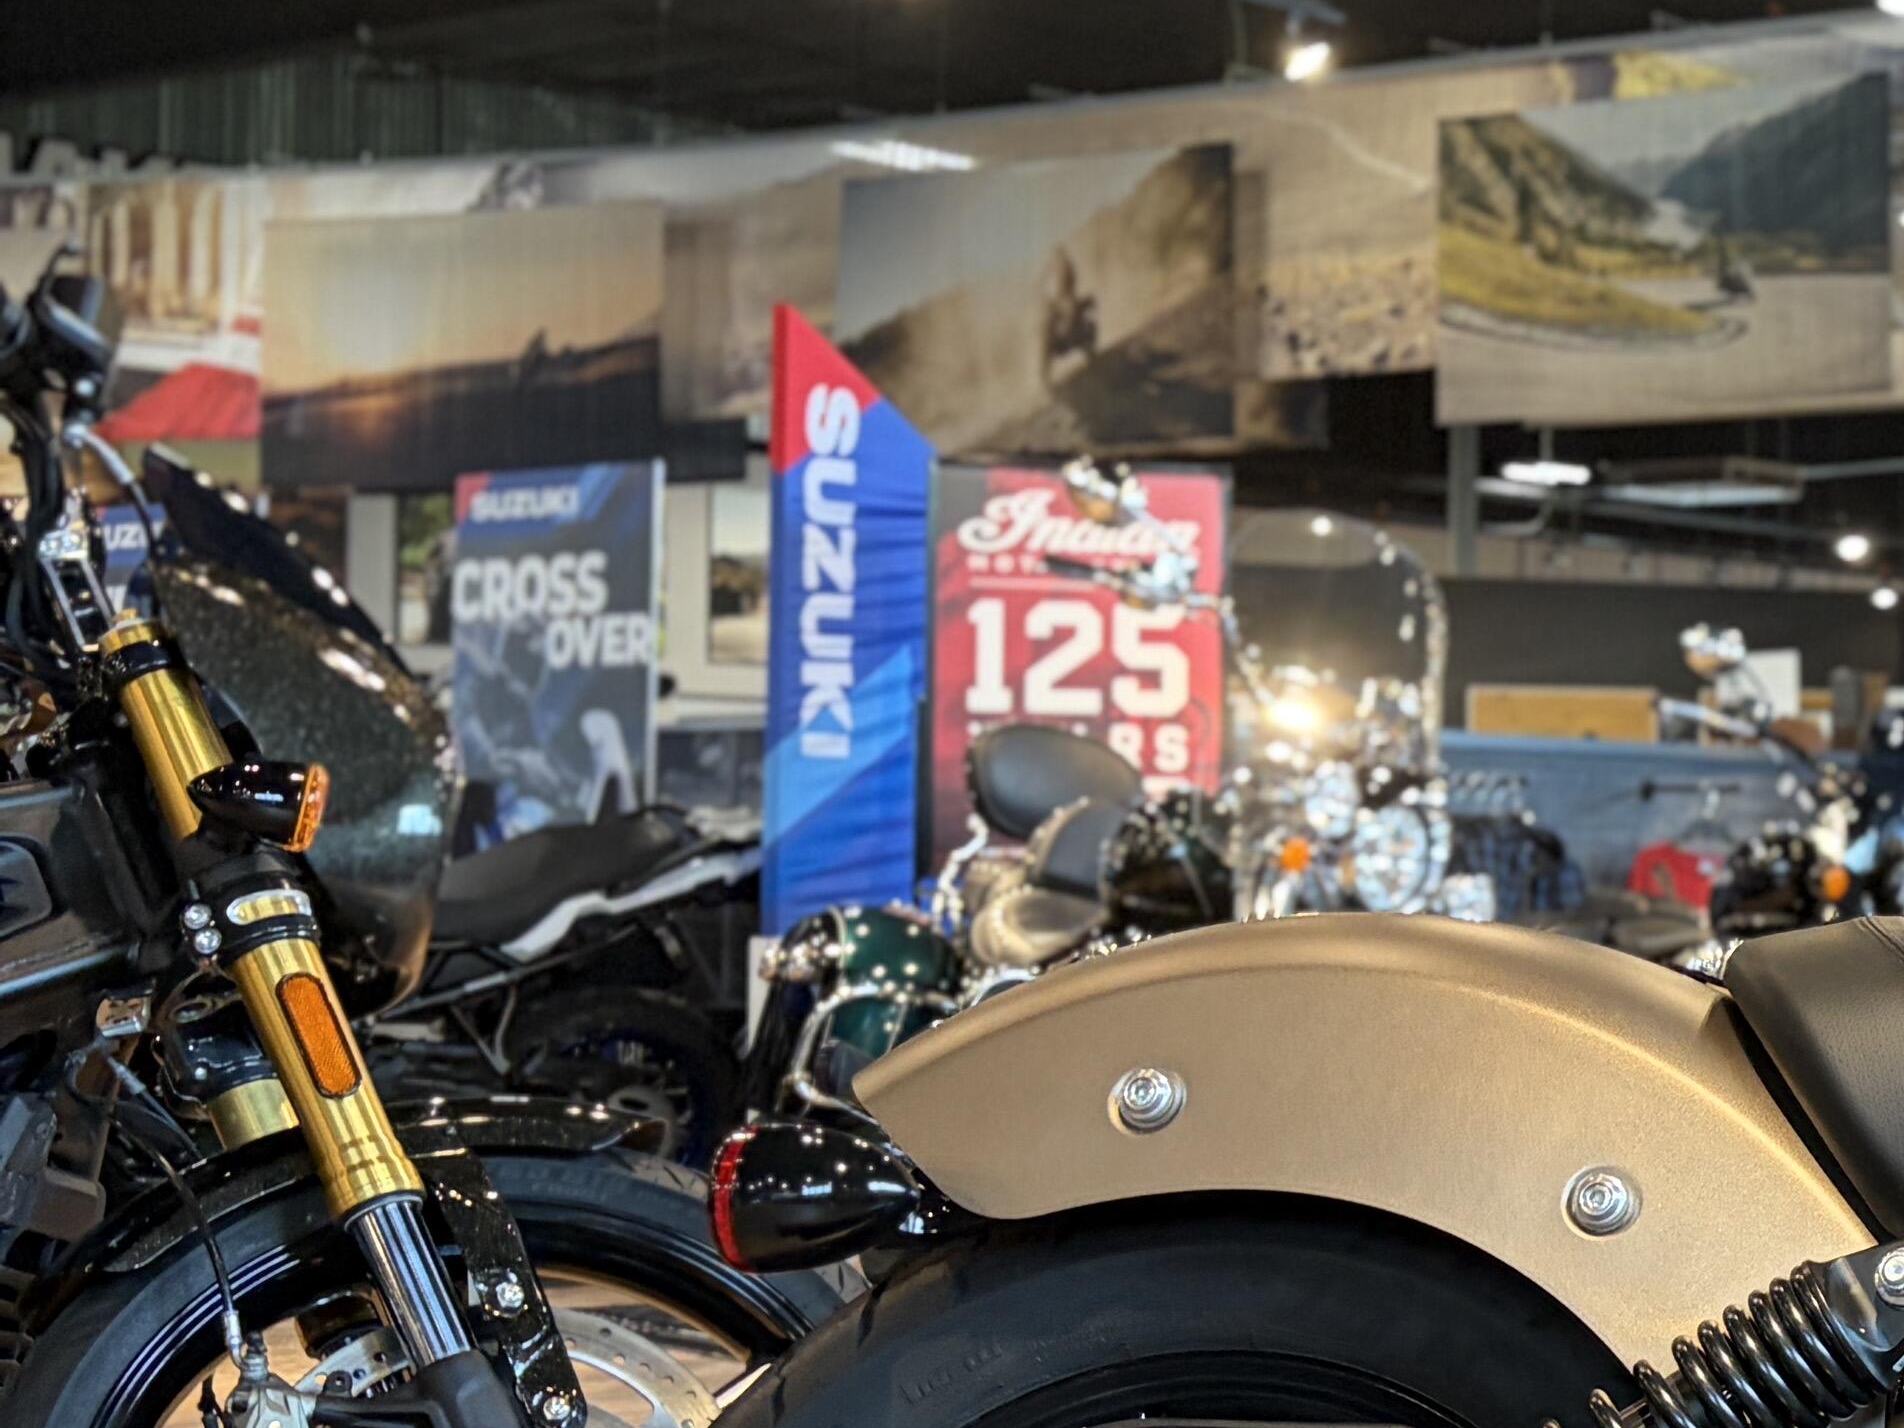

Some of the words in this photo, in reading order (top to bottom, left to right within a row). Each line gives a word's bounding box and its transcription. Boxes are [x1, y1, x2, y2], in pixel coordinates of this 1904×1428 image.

[469, 485, 579, 522] SUZUKI
[453, 550, 608, 622] CROSS
[797, 382, 862, 761] SUZUKI
[545, 612, 652, 670] OVER
[965, 597, 1190, 718] 125
